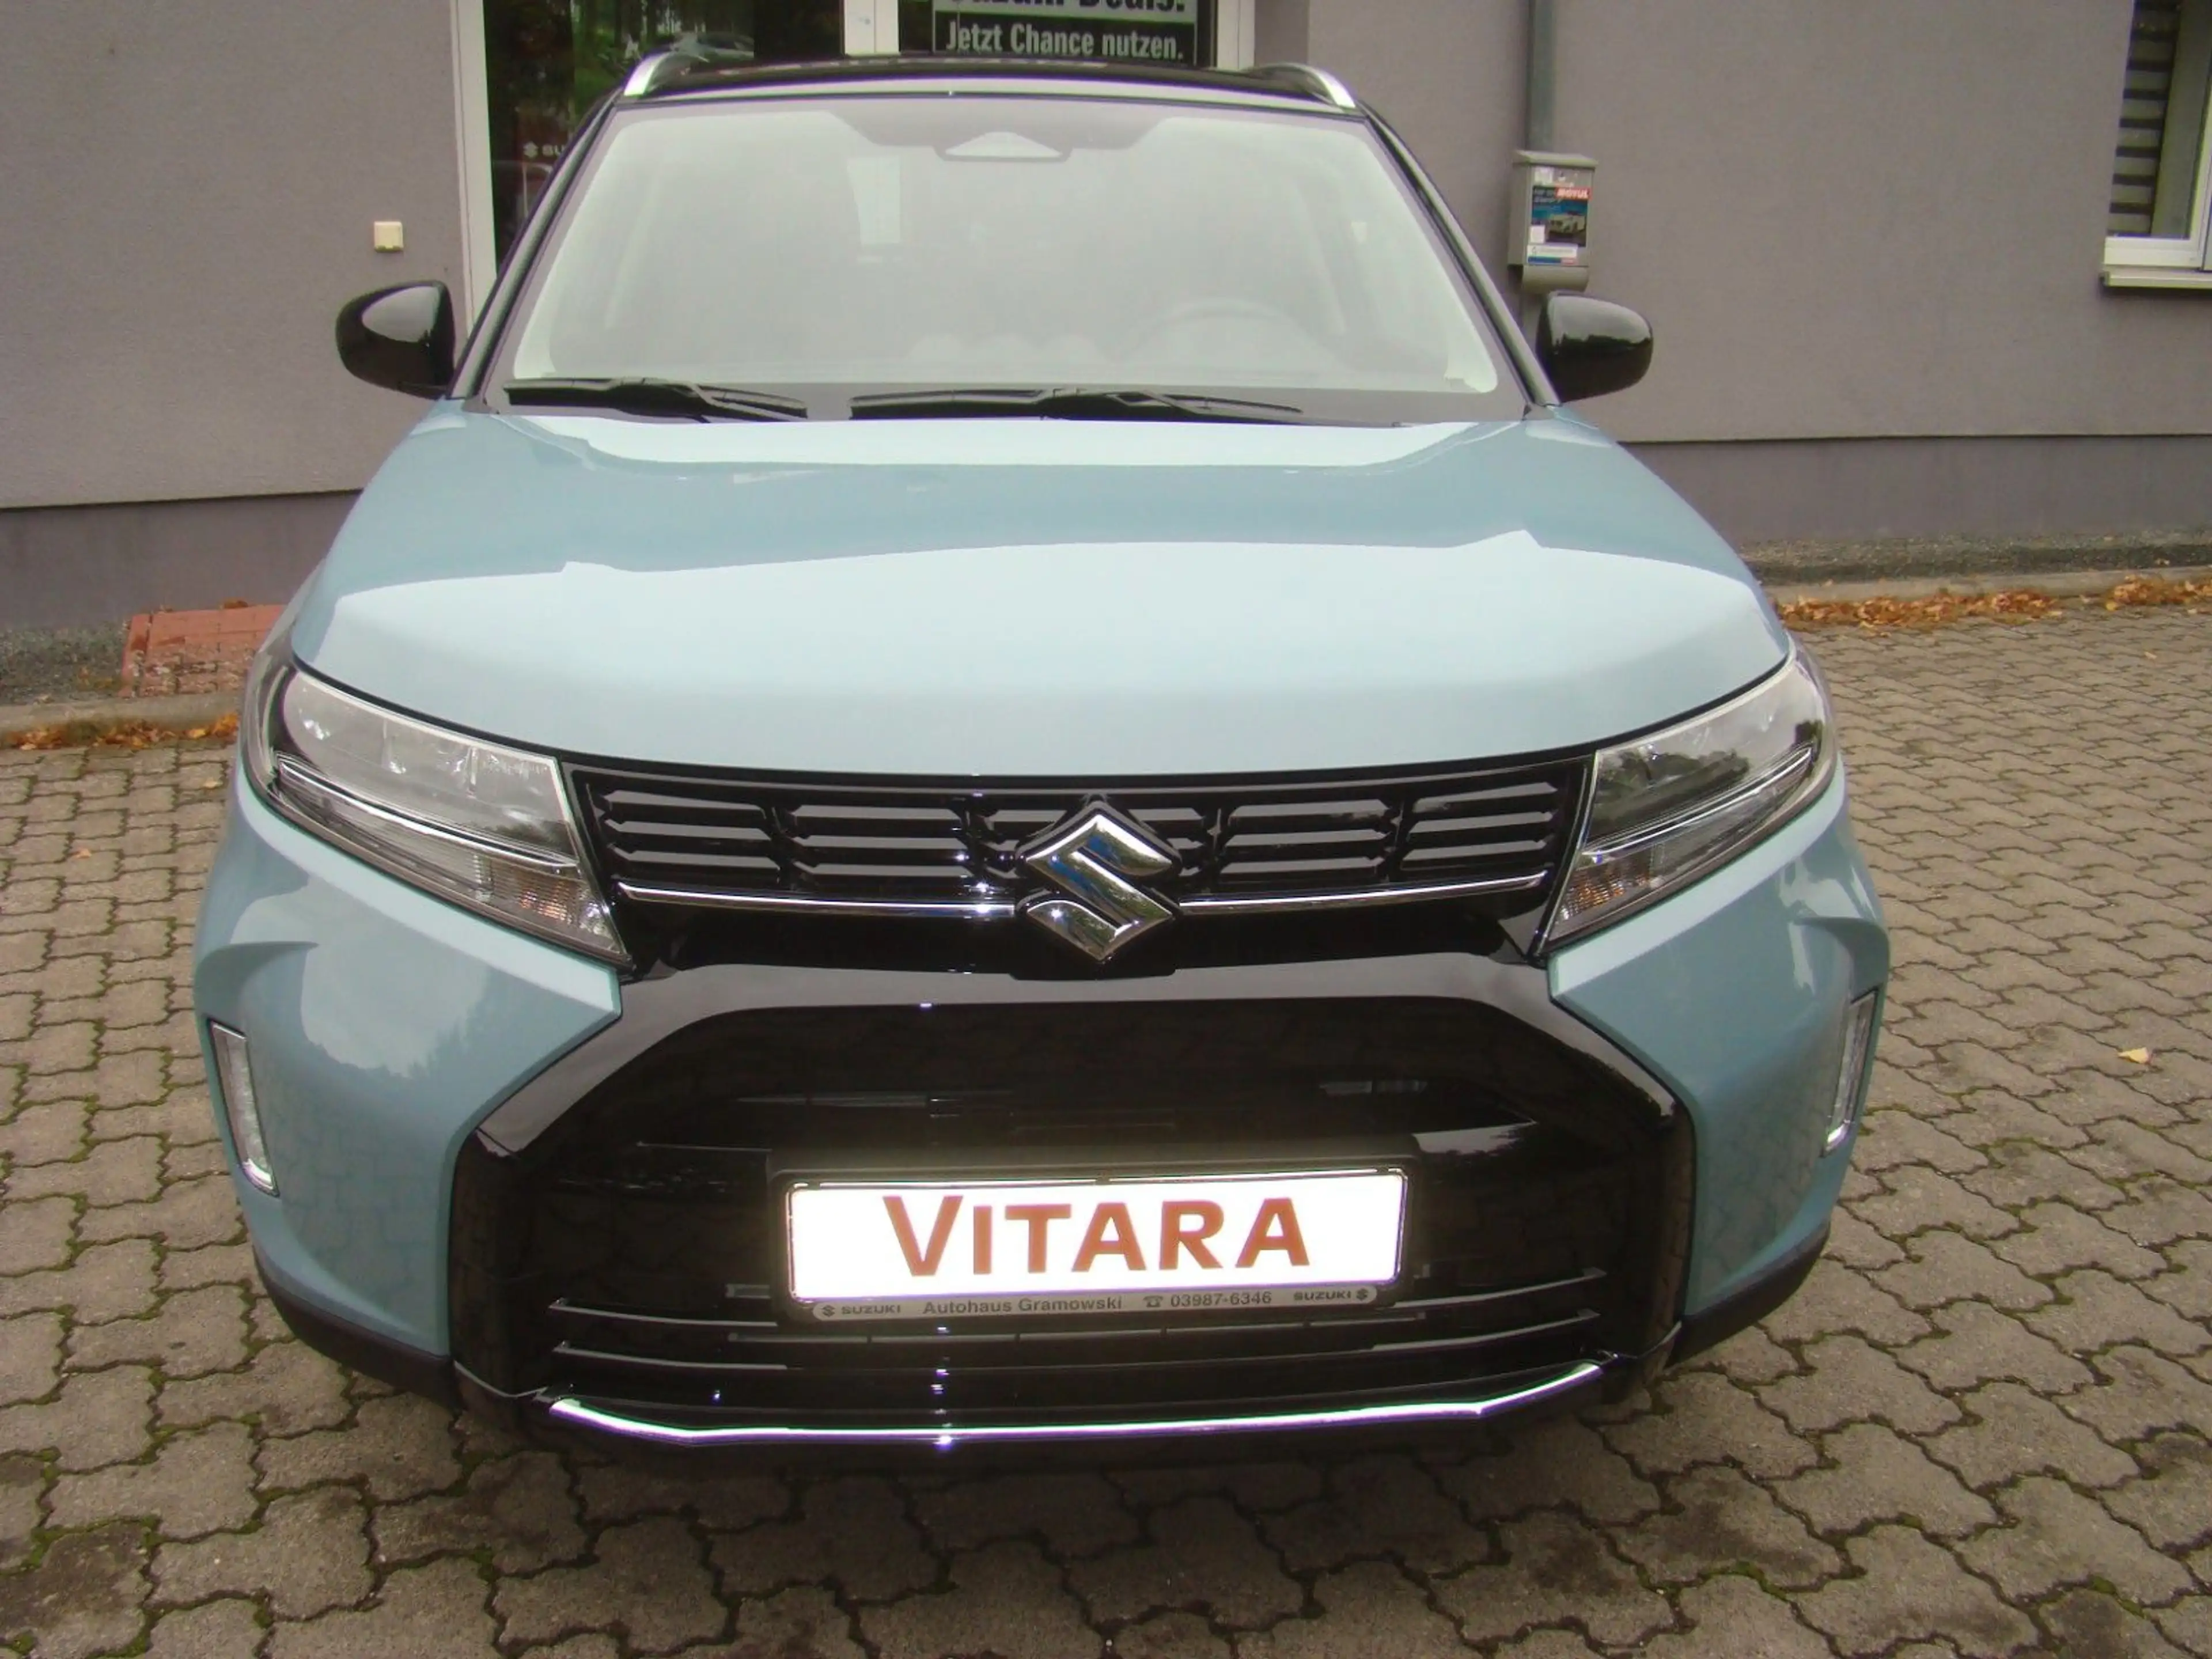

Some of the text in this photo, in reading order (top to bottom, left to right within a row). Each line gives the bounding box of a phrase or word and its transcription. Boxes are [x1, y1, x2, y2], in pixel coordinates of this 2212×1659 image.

[946, 20, 1184, 60] Jetzt Chance nutzen.
[882, 1195, 1310, 1277] VITARA
[842, 1304, 901, 1315] SUZUKI
[923, 1300, 1012, 1314] Autohaus
[1018, 1296, 1122, 1311] Gramowski
[1294, 1290, 1351, 1301] SUZUKI
